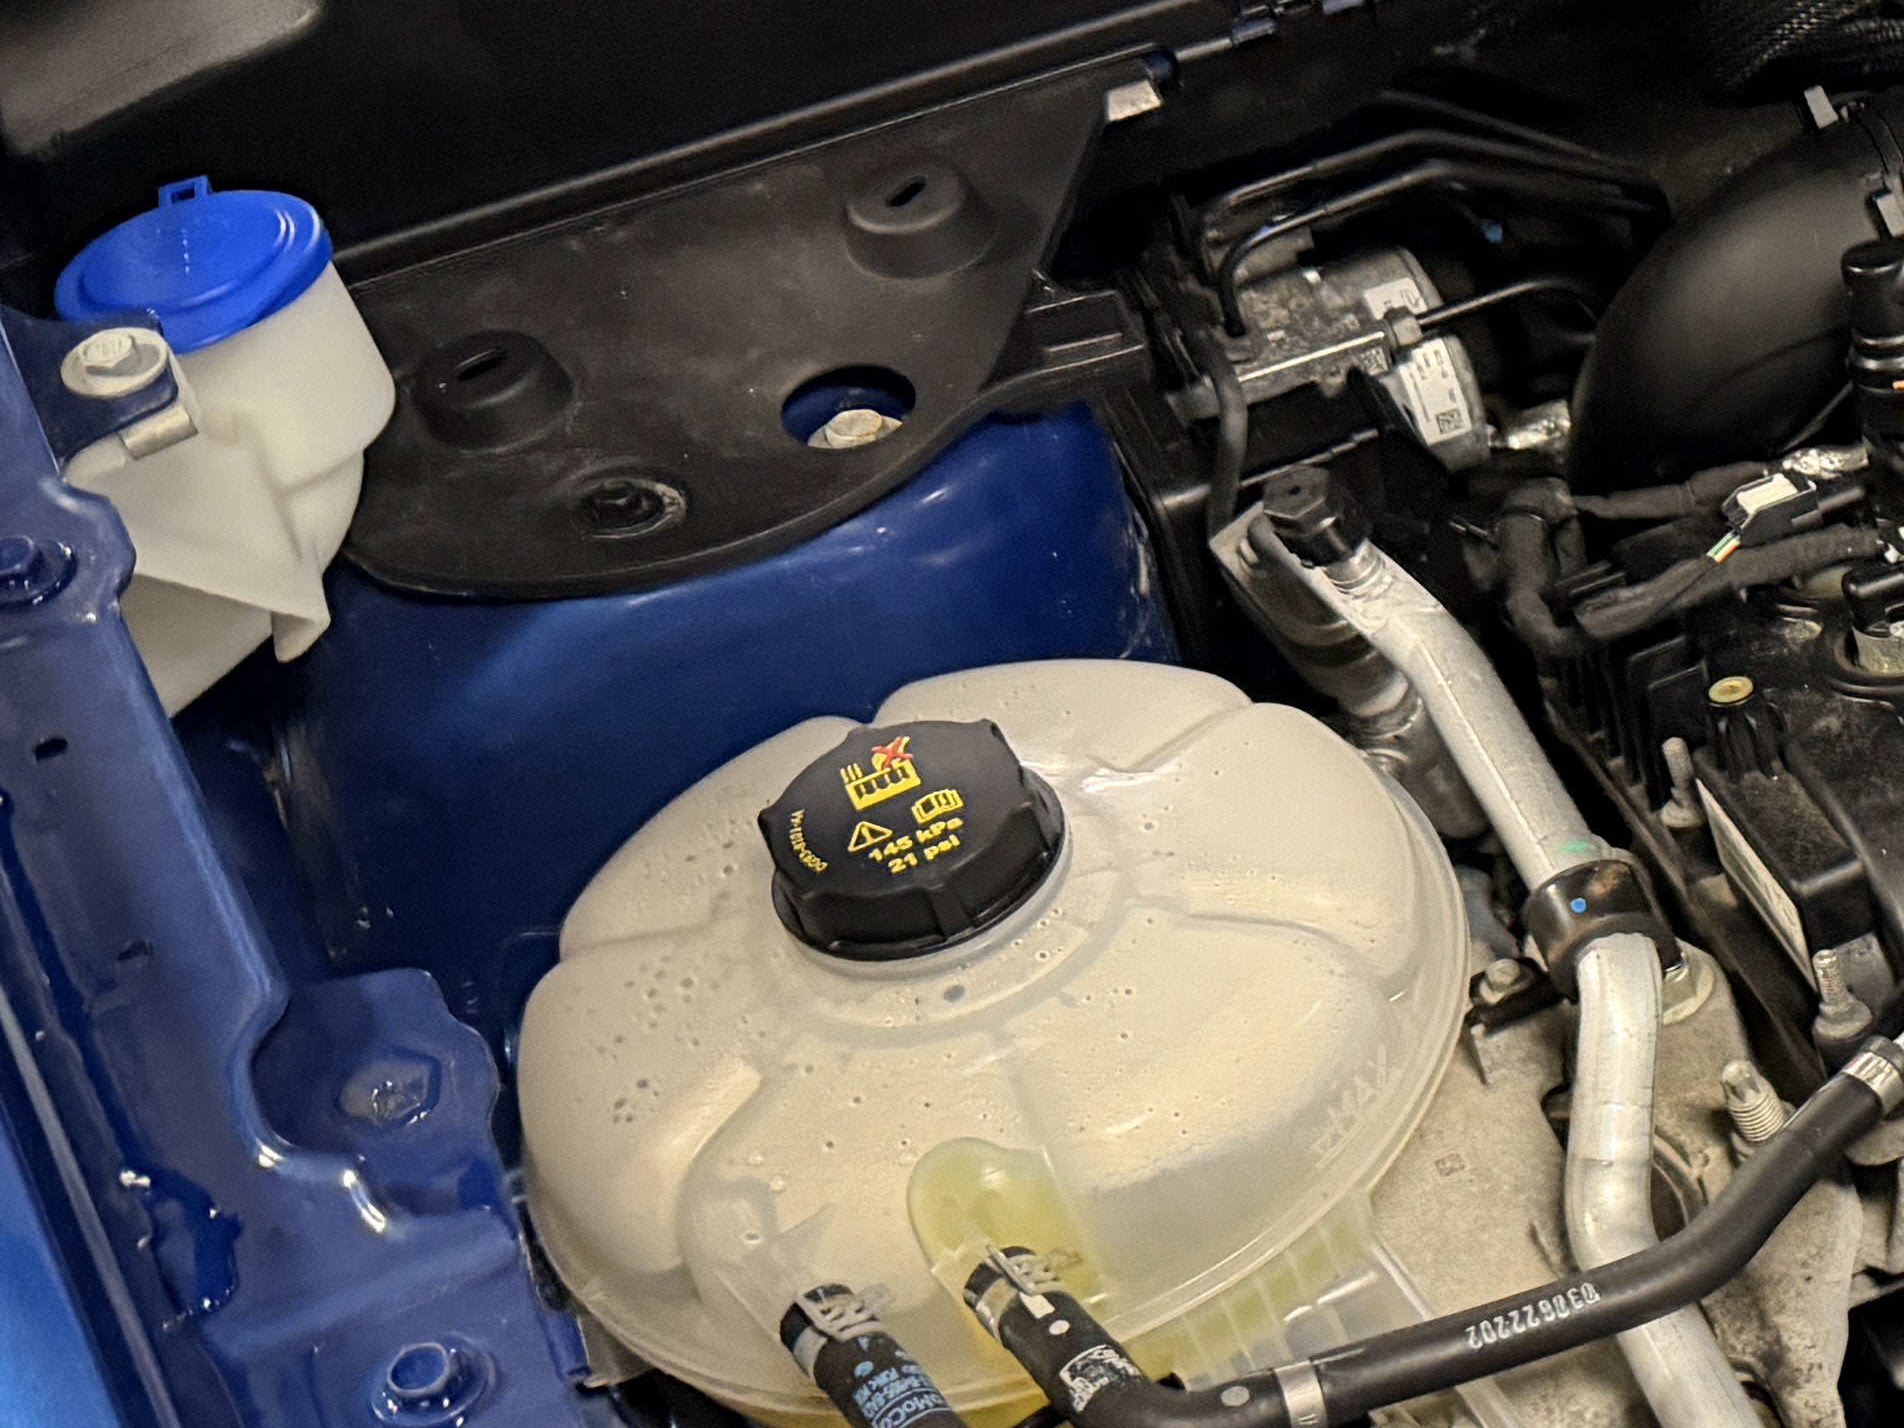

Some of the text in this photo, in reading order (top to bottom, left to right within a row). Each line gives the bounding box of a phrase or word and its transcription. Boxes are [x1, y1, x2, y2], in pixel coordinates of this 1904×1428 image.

[868, 816, 964, 863] 145 kPa
[888, 833, 961, 875] 21 psi
